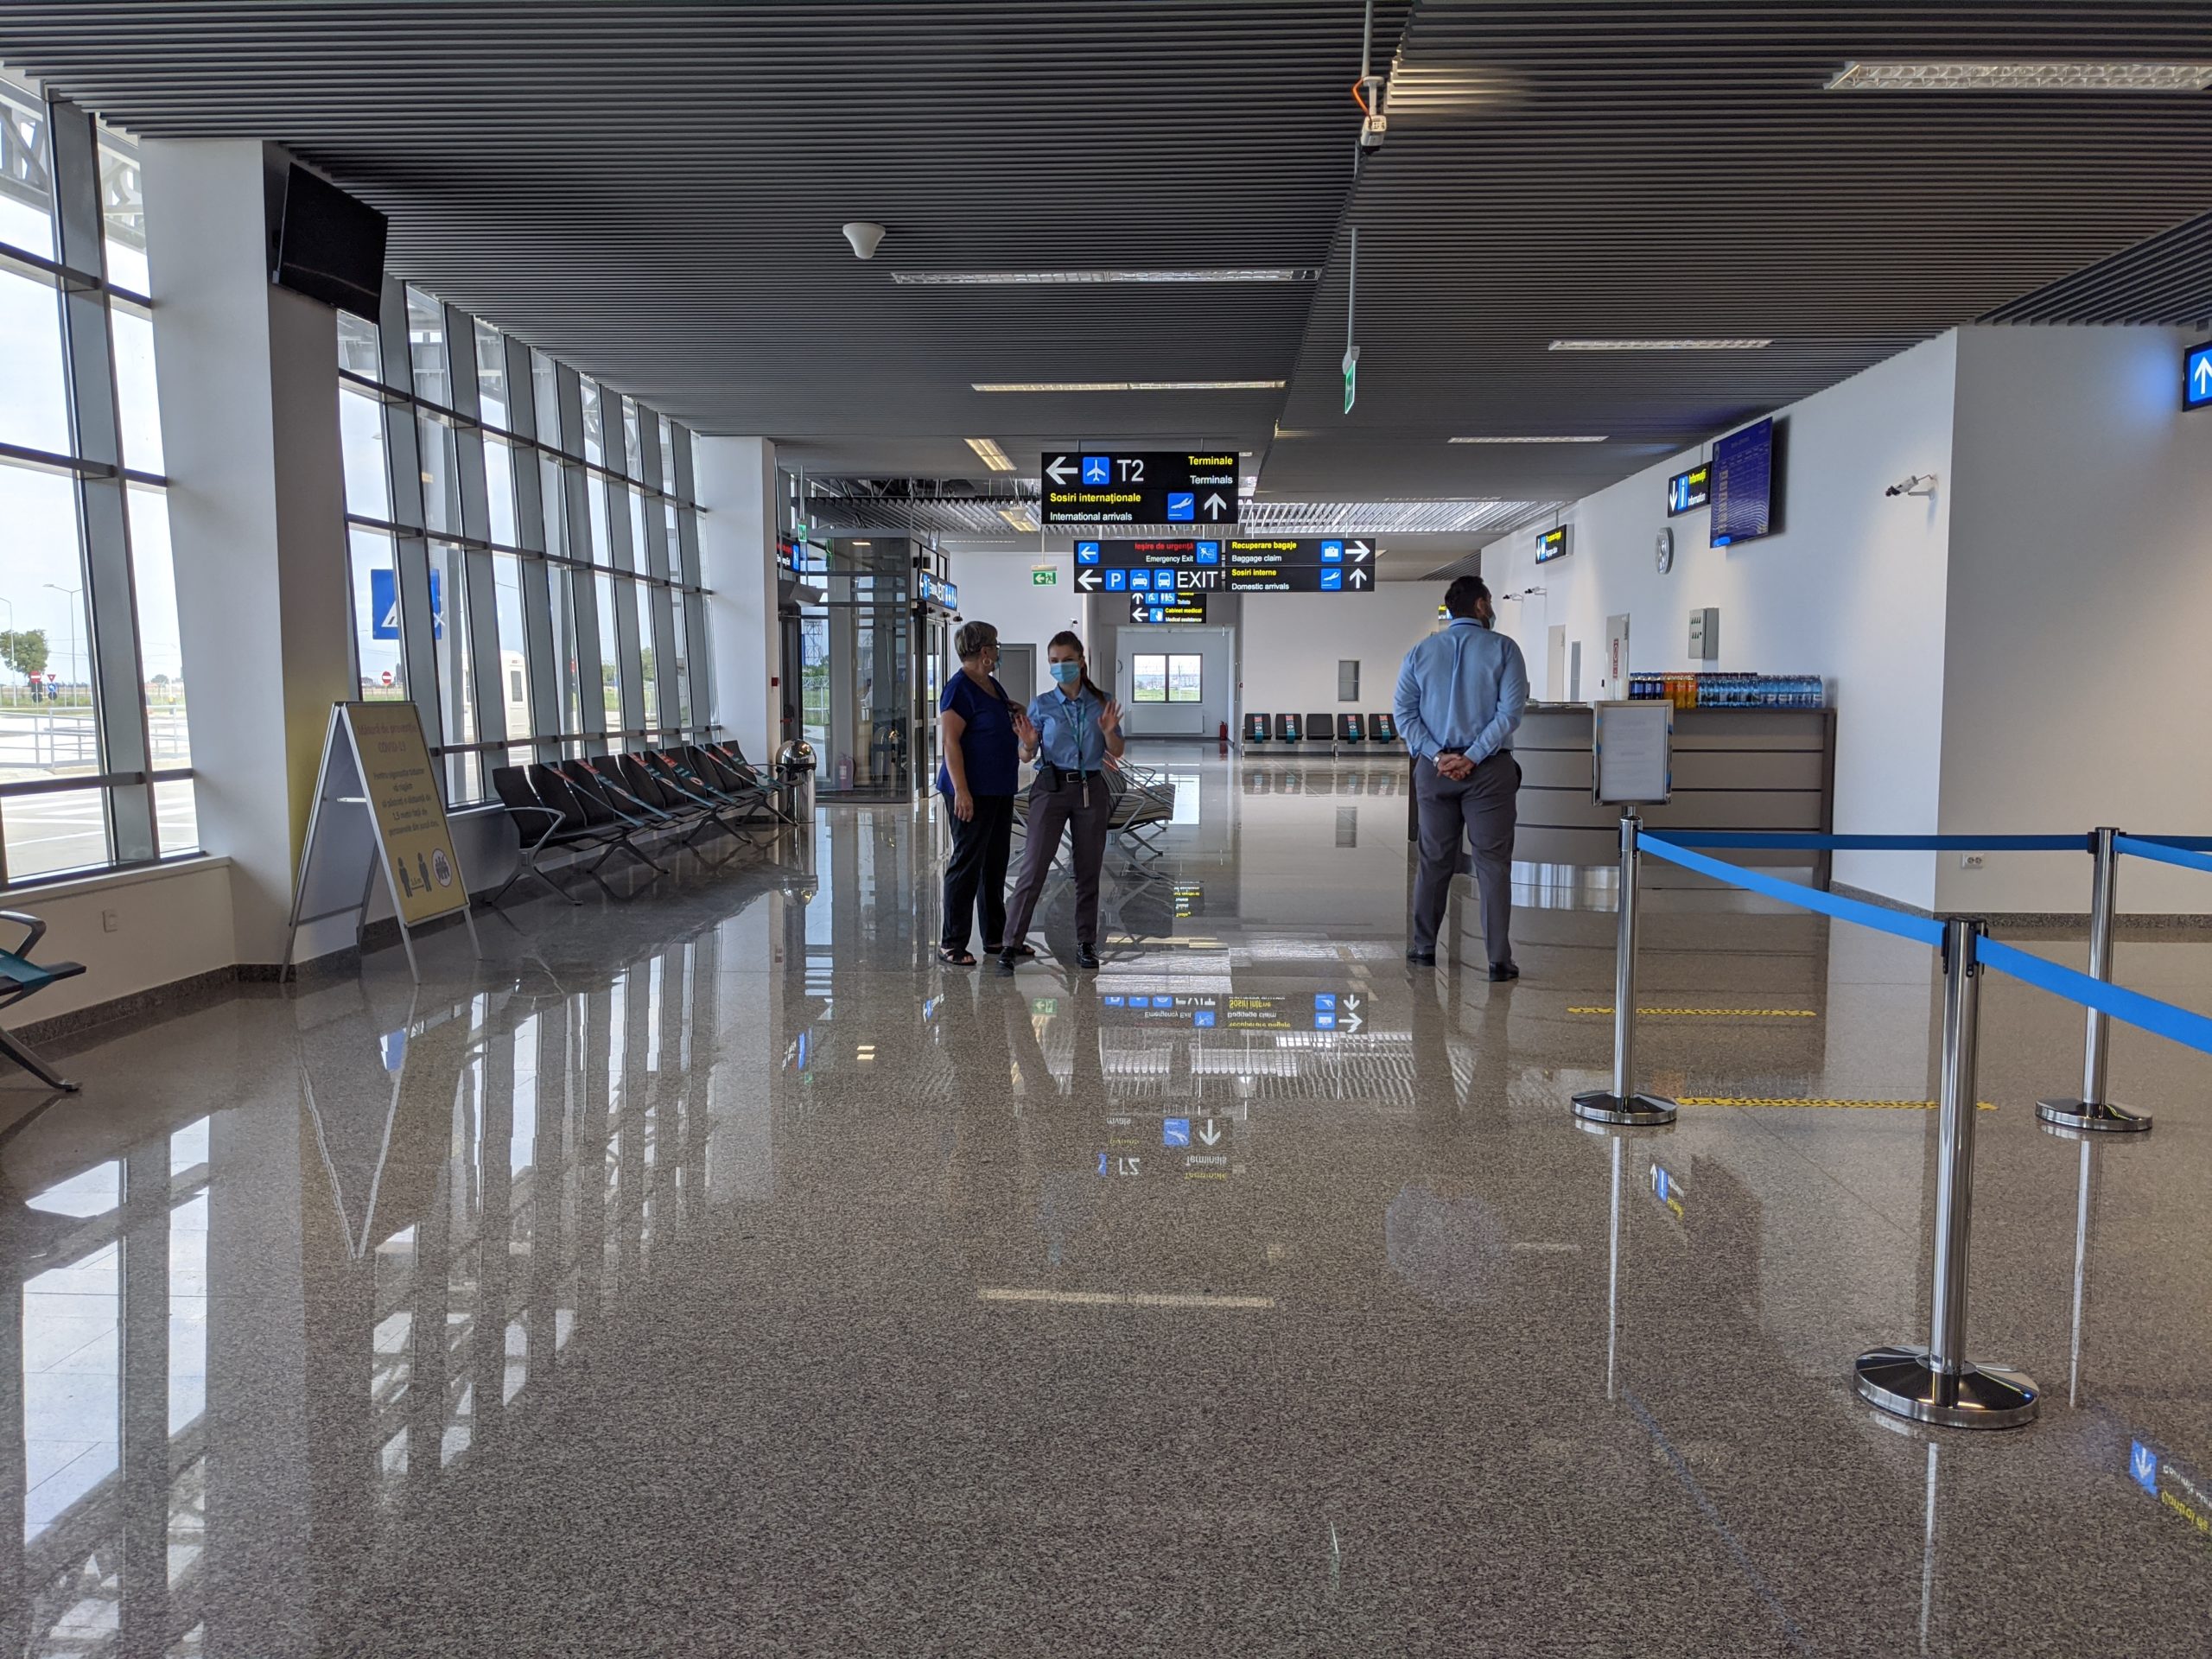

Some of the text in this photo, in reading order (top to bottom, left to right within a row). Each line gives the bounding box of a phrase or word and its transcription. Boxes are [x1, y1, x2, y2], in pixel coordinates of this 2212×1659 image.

[1188, 456, 1233, 466] Terminale
[1116, 459, 1144, 482] T2
[1190, 474, 1233, 485] Terminals
[1050, 493, 1077, 502] Sosiri
[1050, 512, 1133, 521] International arrivals
[1274, 542, 1297, 550] bagaje
[1232, 555, 1262, 563] Baggage
[1177, 571, 1218, 588] EXIT
